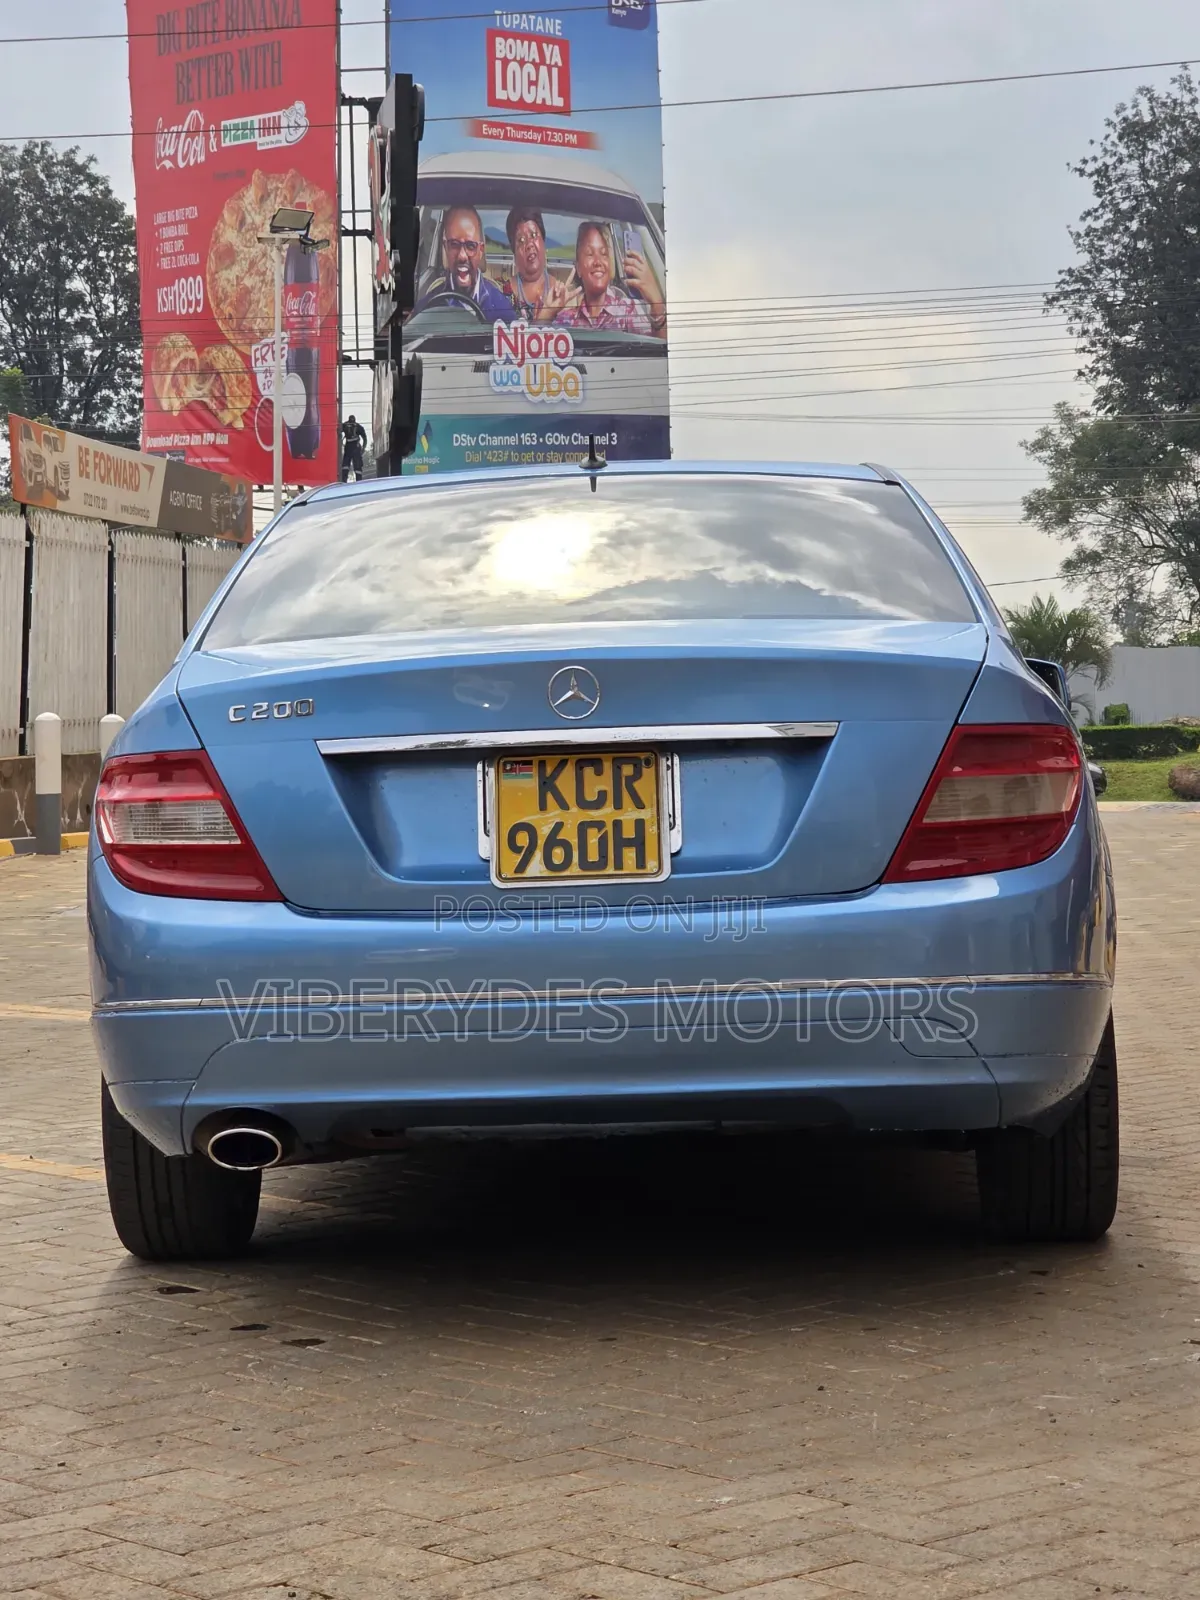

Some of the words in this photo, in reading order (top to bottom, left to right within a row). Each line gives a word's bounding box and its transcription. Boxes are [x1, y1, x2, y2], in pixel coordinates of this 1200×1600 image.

[156, 11, 181, 56] BIG
[185, 3, 220, 50] BITE
[224, 0, 302, 41] BONANZA
[494, 10, 562, 36] TUPATANE
[495, 37, 539, 63] BOMA
[542, 41, 563, 66] YA
[175, 52, 234, 105] BETTER
[239, 40, 283, 91] WITH
[494, 59, 564, 107] LOCAL
[209, 124, 218, 153] &
[222, 119, 256, 144] PIZZA
[258, 115, 282, 138] INN
[482, 124, 505, 139] Every
[506, 126, 542, 143] Thursday
[547, 131, 563, 143] 7.30
[564, 133, 578, 144] PM
[153, 211, 168, 225] LARGE
[185, 206, 198, 219] PIZZA
[160, 256, 171, 270] FREE
[157, 275, 204, 315] KSH1899
[497, 324, 571, 368] Njoro
[492, 370, 521, 386] wa
[525, 363, 580, 398] Uba
[174, 433, 190, 446] Pizza
[202, 432, 216, 445] APP
[453, 433, 476, 446] DStv
[478, 433, 519, 446] Channel
[520, 433, 537, 445] 163
[545, 433, 570, 445] GOtv
[571, 432, 609, 445] Chanel
[610, 432, 618, 445] 3
[78, 445, 90, 480] BE
[93, 450, 141, 493] FORWARD
[423, 456, 440, 466] Magic
[465, 450, 482, 463] Dial
[511, 450, 519, 462] to
[520, 450, 534, 464] get
[536, 452, 544, 462] or
[546, 450, 563, 464] stay
[169, 490, 186, 507] AGENT
[186, 493, 203, 511] OFFICE
[228, 705, 246, 722] C
[251, 698, 314, 720] 200
[537, 756, 646, 811] KCR
[507, 818, 647, 874] 960H
